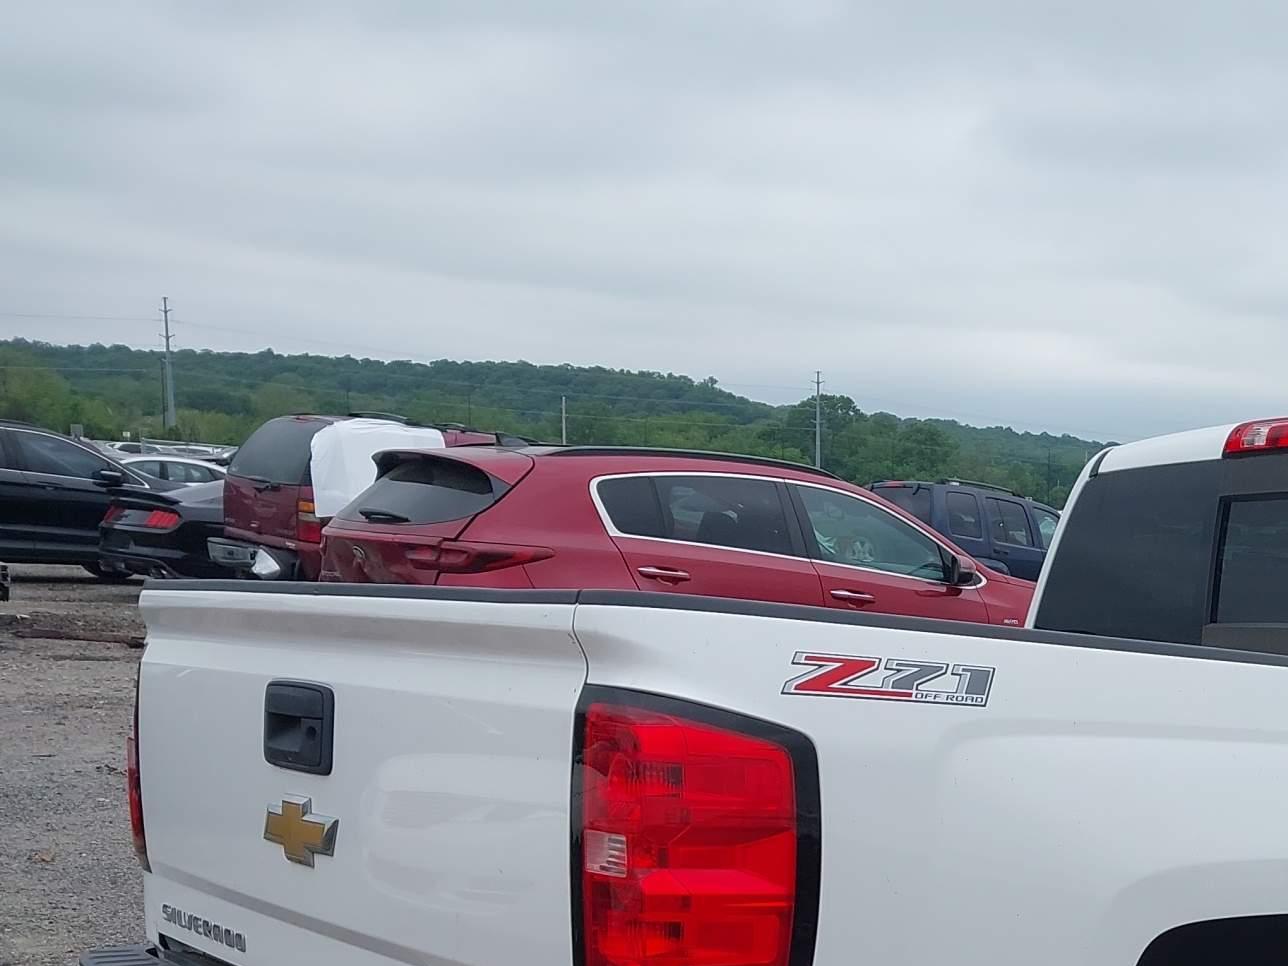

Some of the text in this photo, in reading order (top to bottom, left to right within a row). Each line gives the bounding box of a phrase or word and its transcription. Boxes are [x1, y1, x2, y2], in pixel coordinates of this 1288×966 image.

[781, 651, 996, 707] Z71
[914, 692, 984, 704] OFF ROAD
[162, 904, 247, 953] SILVERADO
